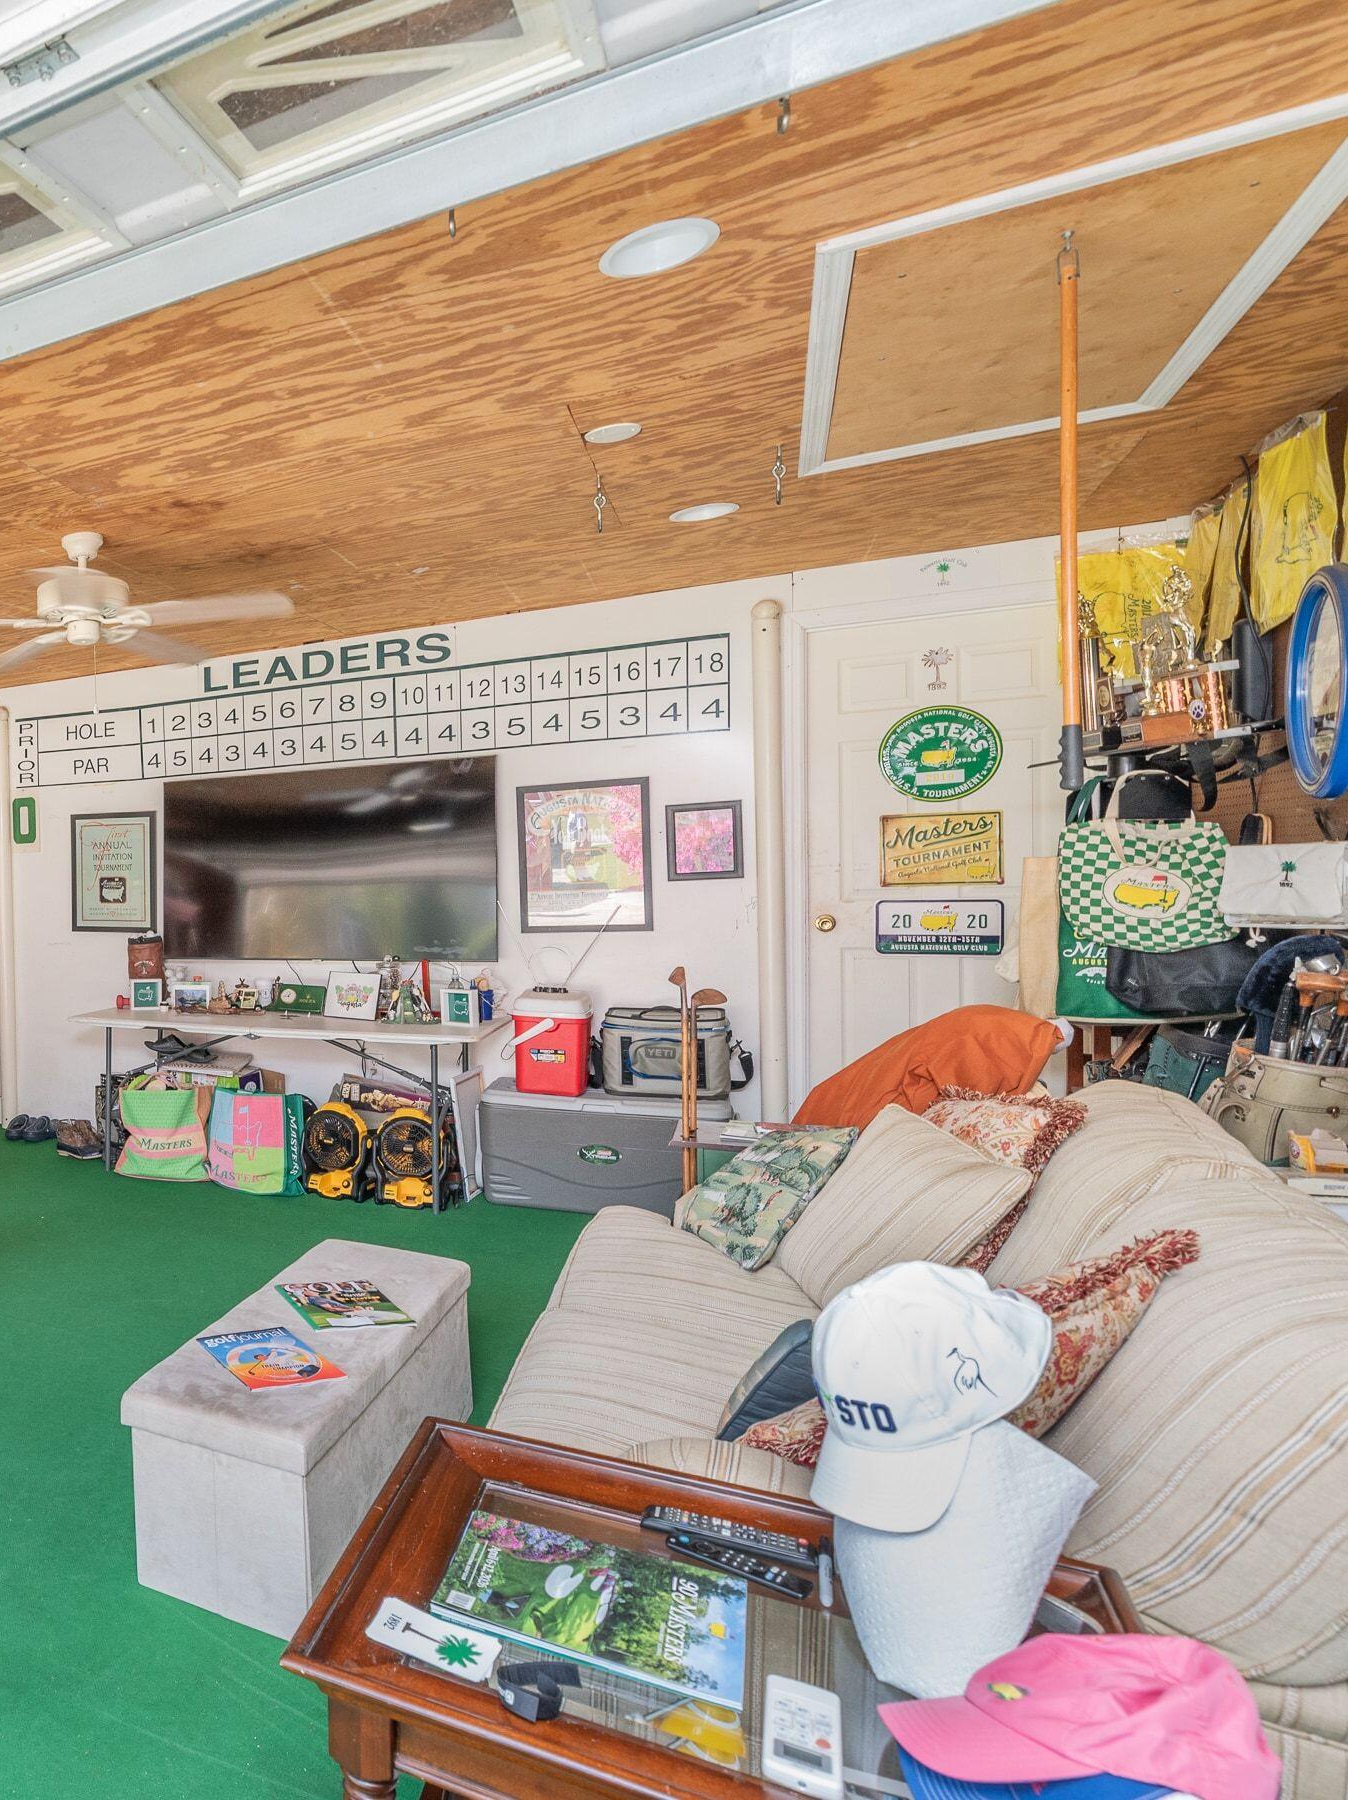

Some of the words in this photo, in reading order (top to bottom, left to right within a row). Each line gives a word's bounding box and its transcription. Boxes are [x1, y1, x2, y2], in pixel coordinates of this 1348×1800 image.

[203, 632, 452, 694] LEADERS
[66, 721, 116, 740] HOLE
[147, 719, 155, 734] 1
[172, 716, 186, 731] 2
[198, 713, 212, 728] 3
[224, 708, 239, 725] 4
[252, 705, 267, 722] 5
[280, 702, 296, 718] 6
[309, 698, 325, 715] 7
[339, 695, 355, 712] 8
[370, 691, 387, 710] 9
[402, 686, 424, 706] 10
[434, 682, 454, 702] 11
[467, 678, 491, 699] 12
[501, 674, 527, 695] 13
[537, 670, 563, 690] 14
[574, 666, 602, 686] 15
[613, 661, 641, 682] 16
[653, 656, 682, 678] 17
[695, 652, 724, 674] 18
[73, 757, 109, 775] PAR
[148, 754, 161, 769] 4
[173, 751, 187, 767] 5
[199, 748, 213, 764] 4
[225, 746, 240, 761] 3
[253, 742, 268, 758] 4
[281, 739, 297, 756] 3
[310, 736, 326, 752] 4
[341, 733, 357, 750] 5
[371, 730, 388, 748] 4
[404, 727, 423, 745] 4
[438, 724, 456, 742] 4
[472, 721, 490, 739] 3
[507, 717, 525, 735] 5
[542, 713, 563, 732] 4
[581, 710, 601, 729] 5
[619, 706, 641, 725] 3
[659, 702, 682, 721] 4
[701, 698, 724, 718] 4
[891, 722, 988, 759] MASTERS
[17, 724, 35, 783] PRIOR
[923, 775, 983, 797] TOURNAMENT
[92, 841, 132, 850] ANNUAL
[886, 815, 993, 849] Masters
[92, 853, 132, 861] INVITATION
[893, 840, 991, 868] TOURNAMENT
[891, 914, 911, 928] 20
[967, 914, 987, 929] 20
[647, 1048, 673, 1057] YETI
[139, 1138, 192, 1152] MASTERS
